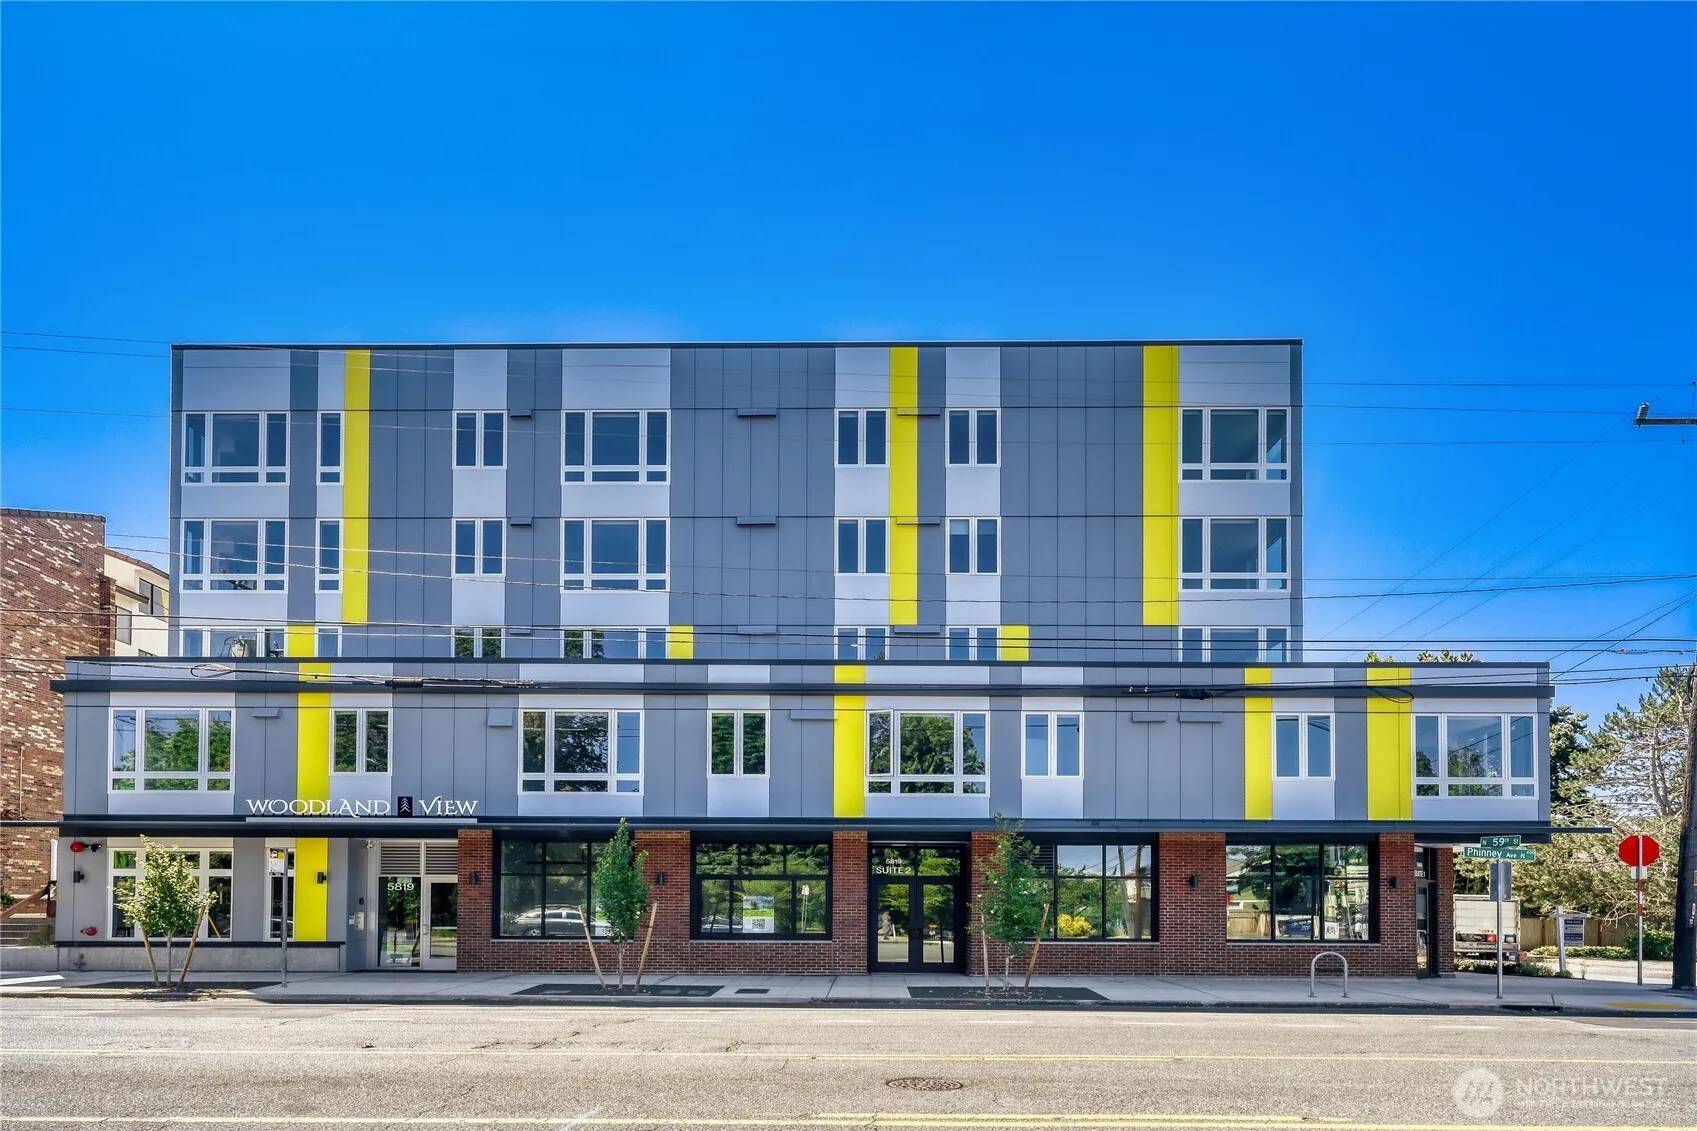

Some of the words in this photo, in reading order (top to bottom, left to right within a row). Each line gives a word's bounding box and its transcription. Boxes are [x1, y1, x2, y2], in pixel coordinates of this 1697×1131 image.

[246, 798, 391, 818] WOODLAND
[418, 795, 479, 815] VIEW
[1492, 837, 1509, 847] 59th
[1467, 847, 1502, 858] Phinney
[876, 866, 903, 874] SUITE
[905, 866, 912, 874] 2
[387, 882, 415, 891] 5819
